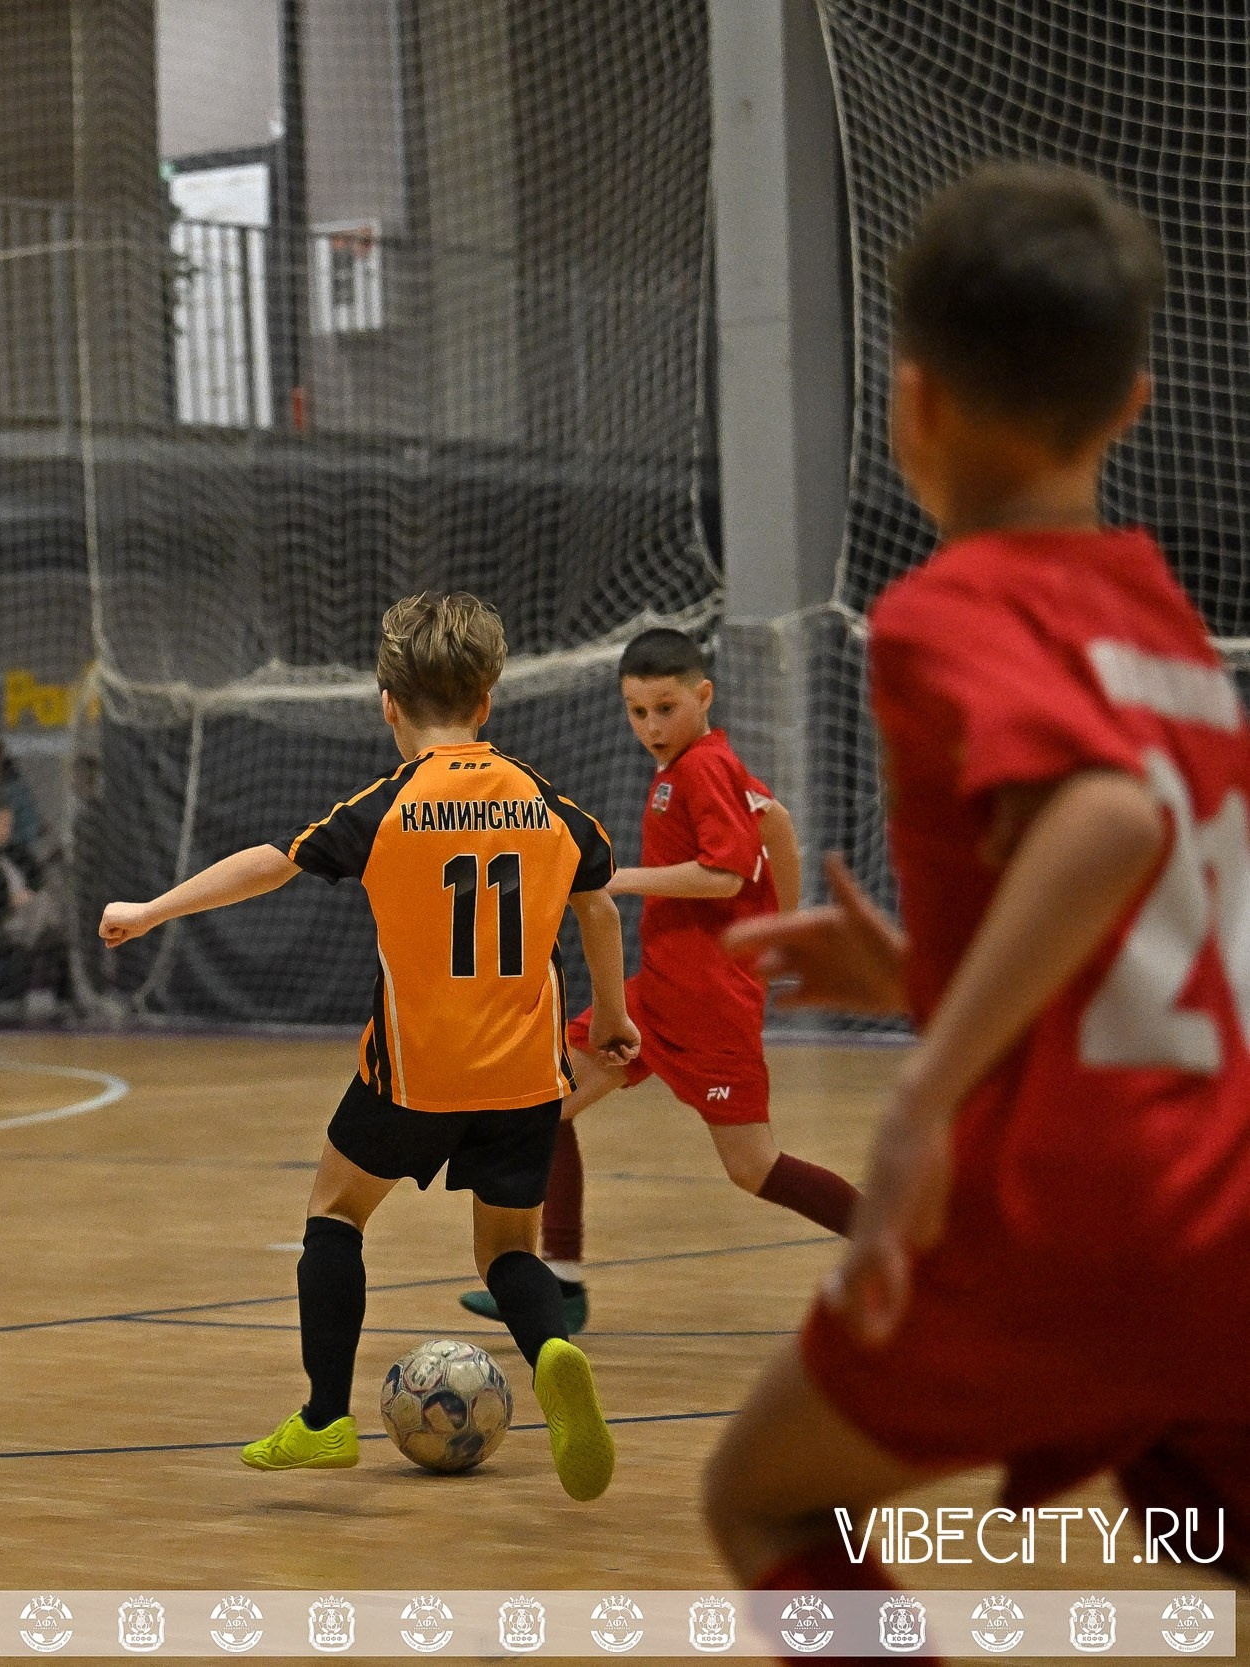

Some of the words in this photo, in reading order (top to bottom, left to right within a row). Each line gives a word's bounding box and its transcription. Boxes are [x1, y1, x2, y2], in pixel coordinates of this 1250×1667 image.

[448, 761, 492, 770] SAF
[400, 796, 552, 832] КАМИНСКИЙ
[441, 851, 525, 979] 11
